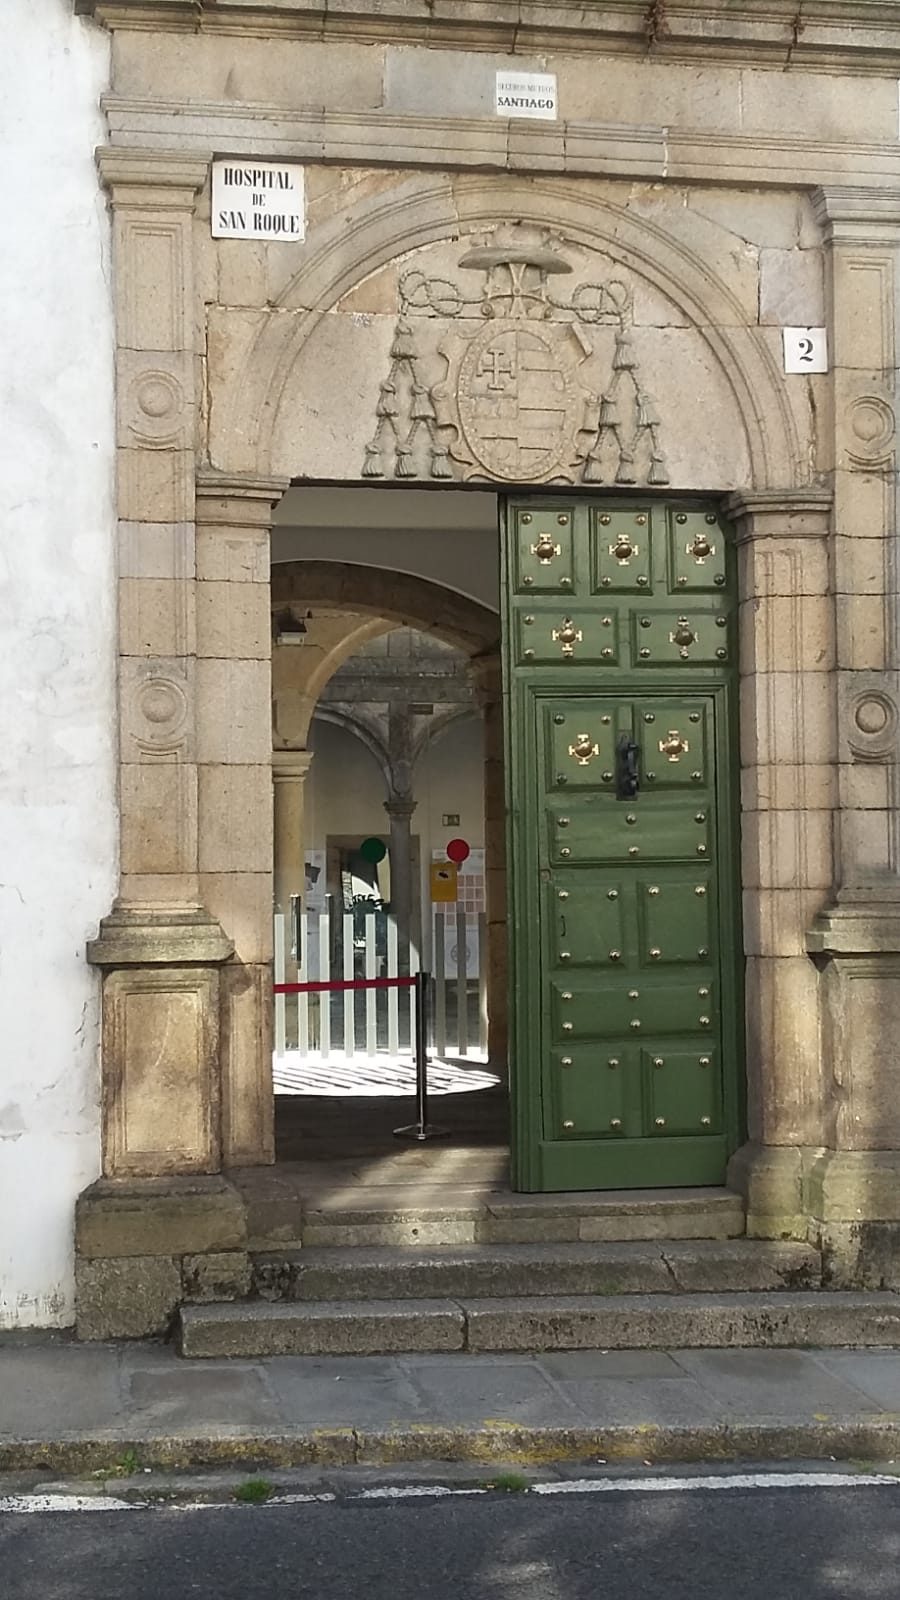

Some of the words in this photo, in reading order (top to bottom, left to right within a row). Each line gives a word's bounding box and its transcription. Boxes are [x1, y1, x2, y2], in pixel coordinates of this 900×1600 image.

[498, 97, 554, 109] SANTIAGO
[224, 168, 293, 190] HOSPITAL
[252, 193, 266, 206] DE
[219, 211, 246, 229] SAN
[254, 213, 299, 234] ROQUE
[799, 338, 814, 362] 2
